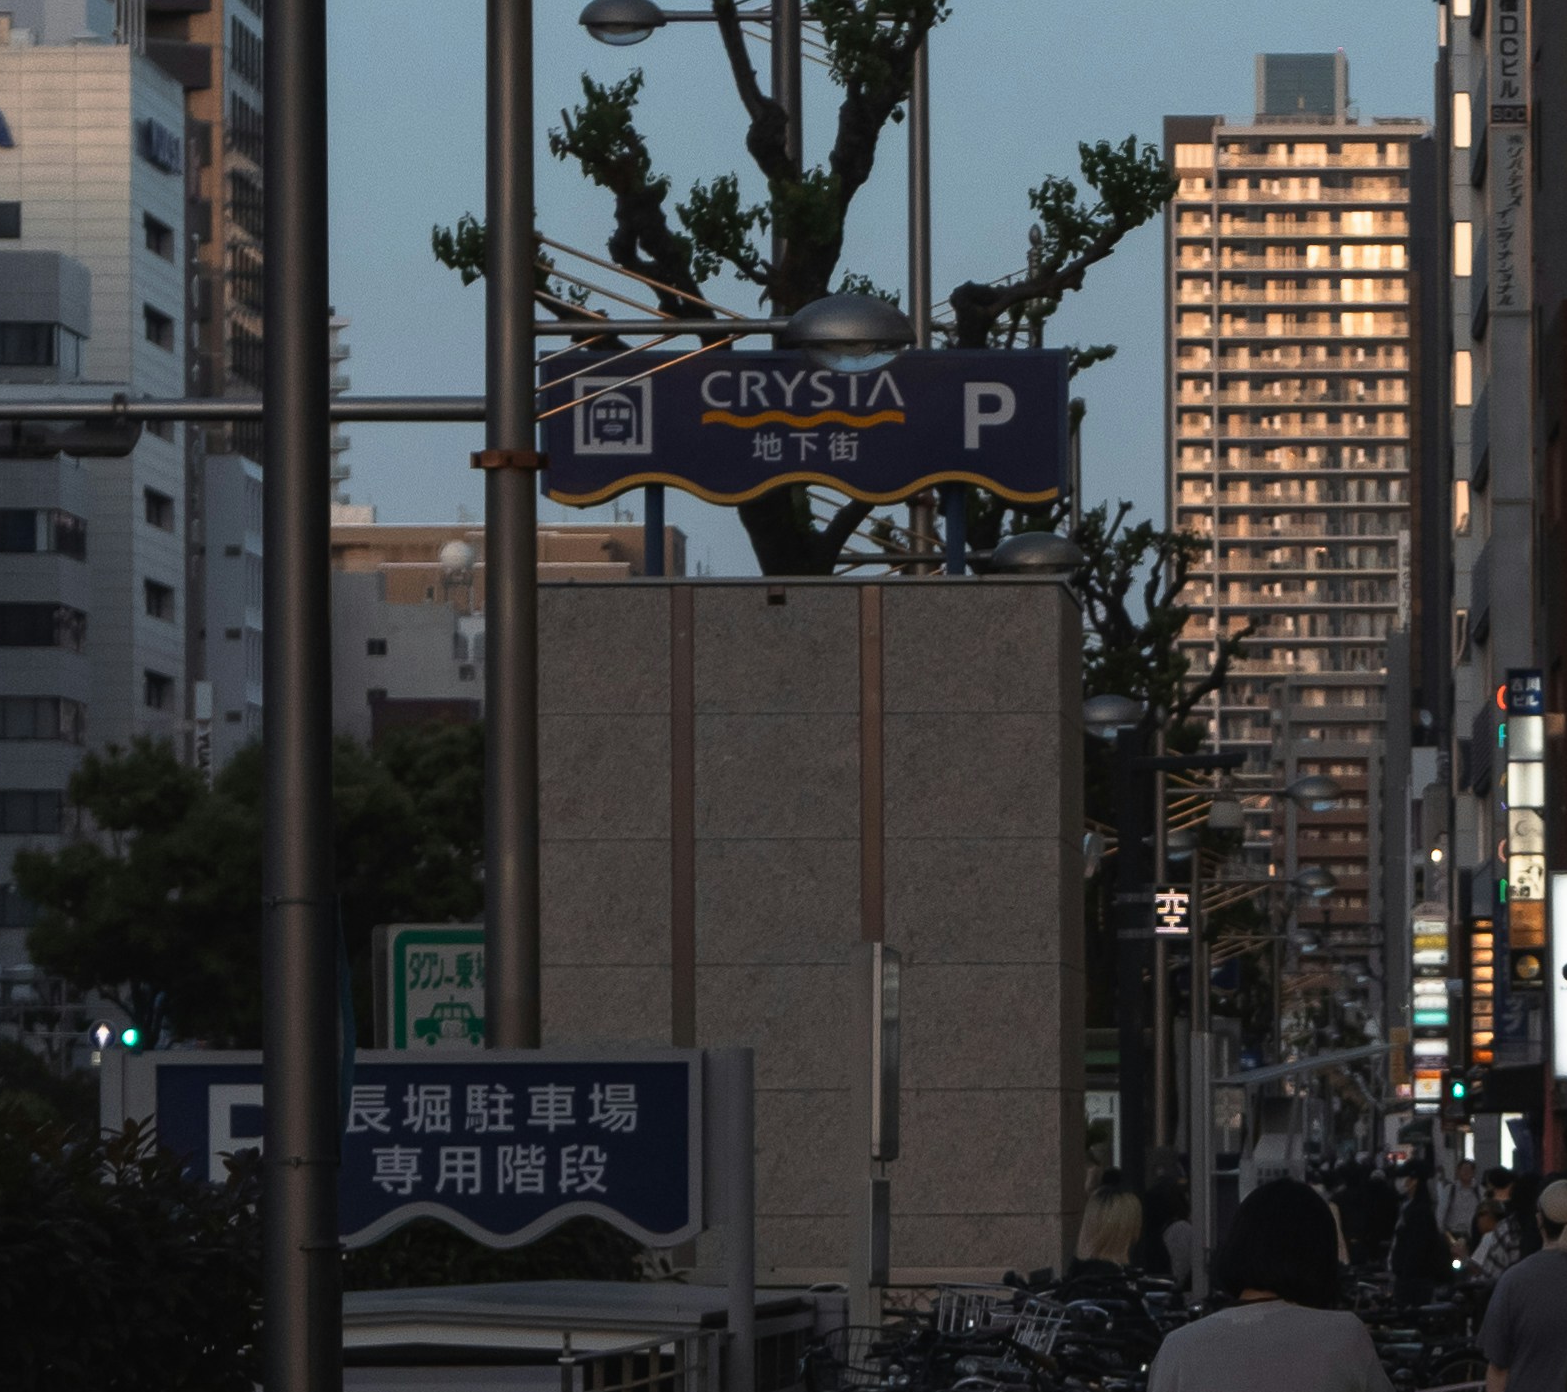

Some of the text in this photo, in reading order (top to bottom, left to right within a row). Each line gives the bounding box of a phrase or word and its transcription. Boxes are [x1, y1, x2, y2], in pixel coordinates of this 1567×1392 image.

[699, 369, 906, 409] CRYSTA
[962, 381, 1018, 450] P
[752, 431, 861, 463] 地下街
[343, 1082, 640, 1135] 長堀駐車場
[370, 1142, 610, 1196] 専用階段
